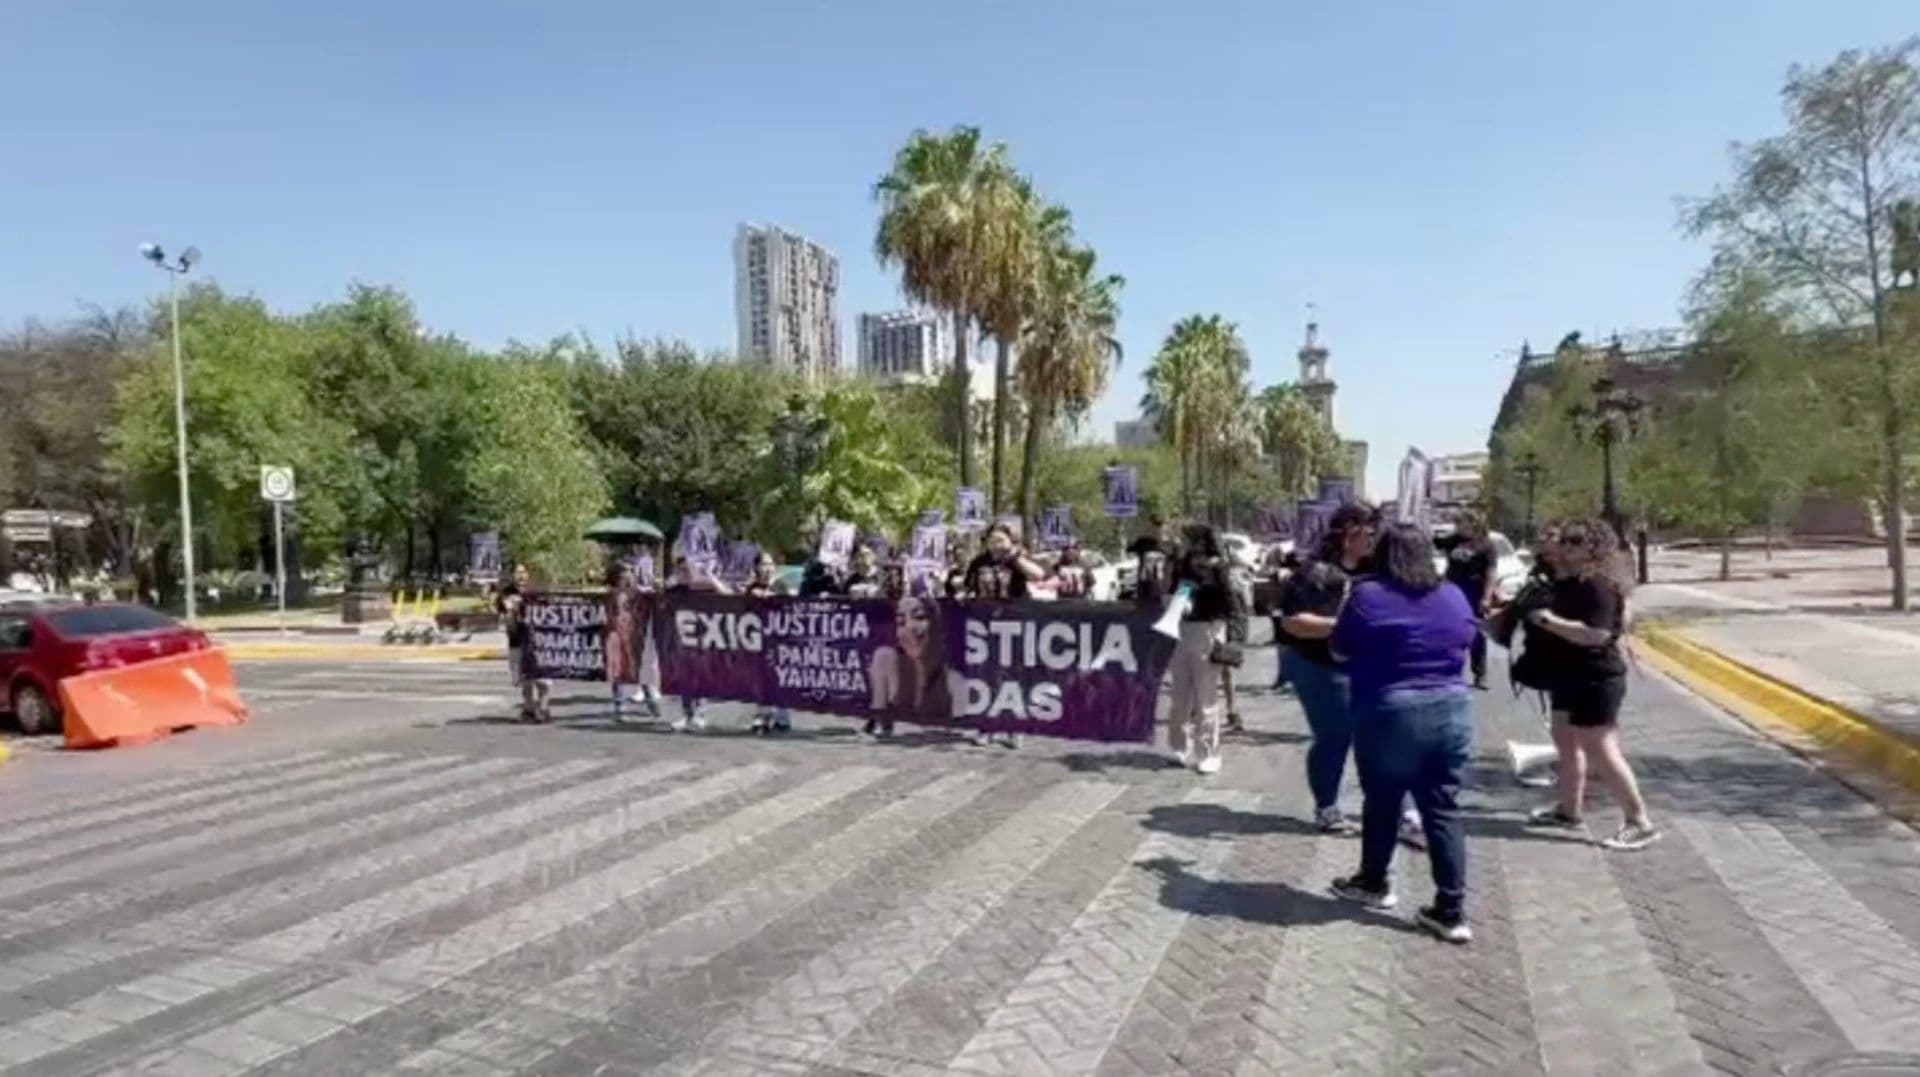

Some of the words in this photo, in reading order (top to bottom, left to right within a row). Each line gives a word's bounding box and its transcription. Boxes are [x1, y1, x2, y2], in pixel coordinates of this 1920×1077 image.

[763, 611, 870, 638] JUSTICIA
[777, 646, 860, 669] PAMELA
[774, 665, 867, 693] YAHAIRA
